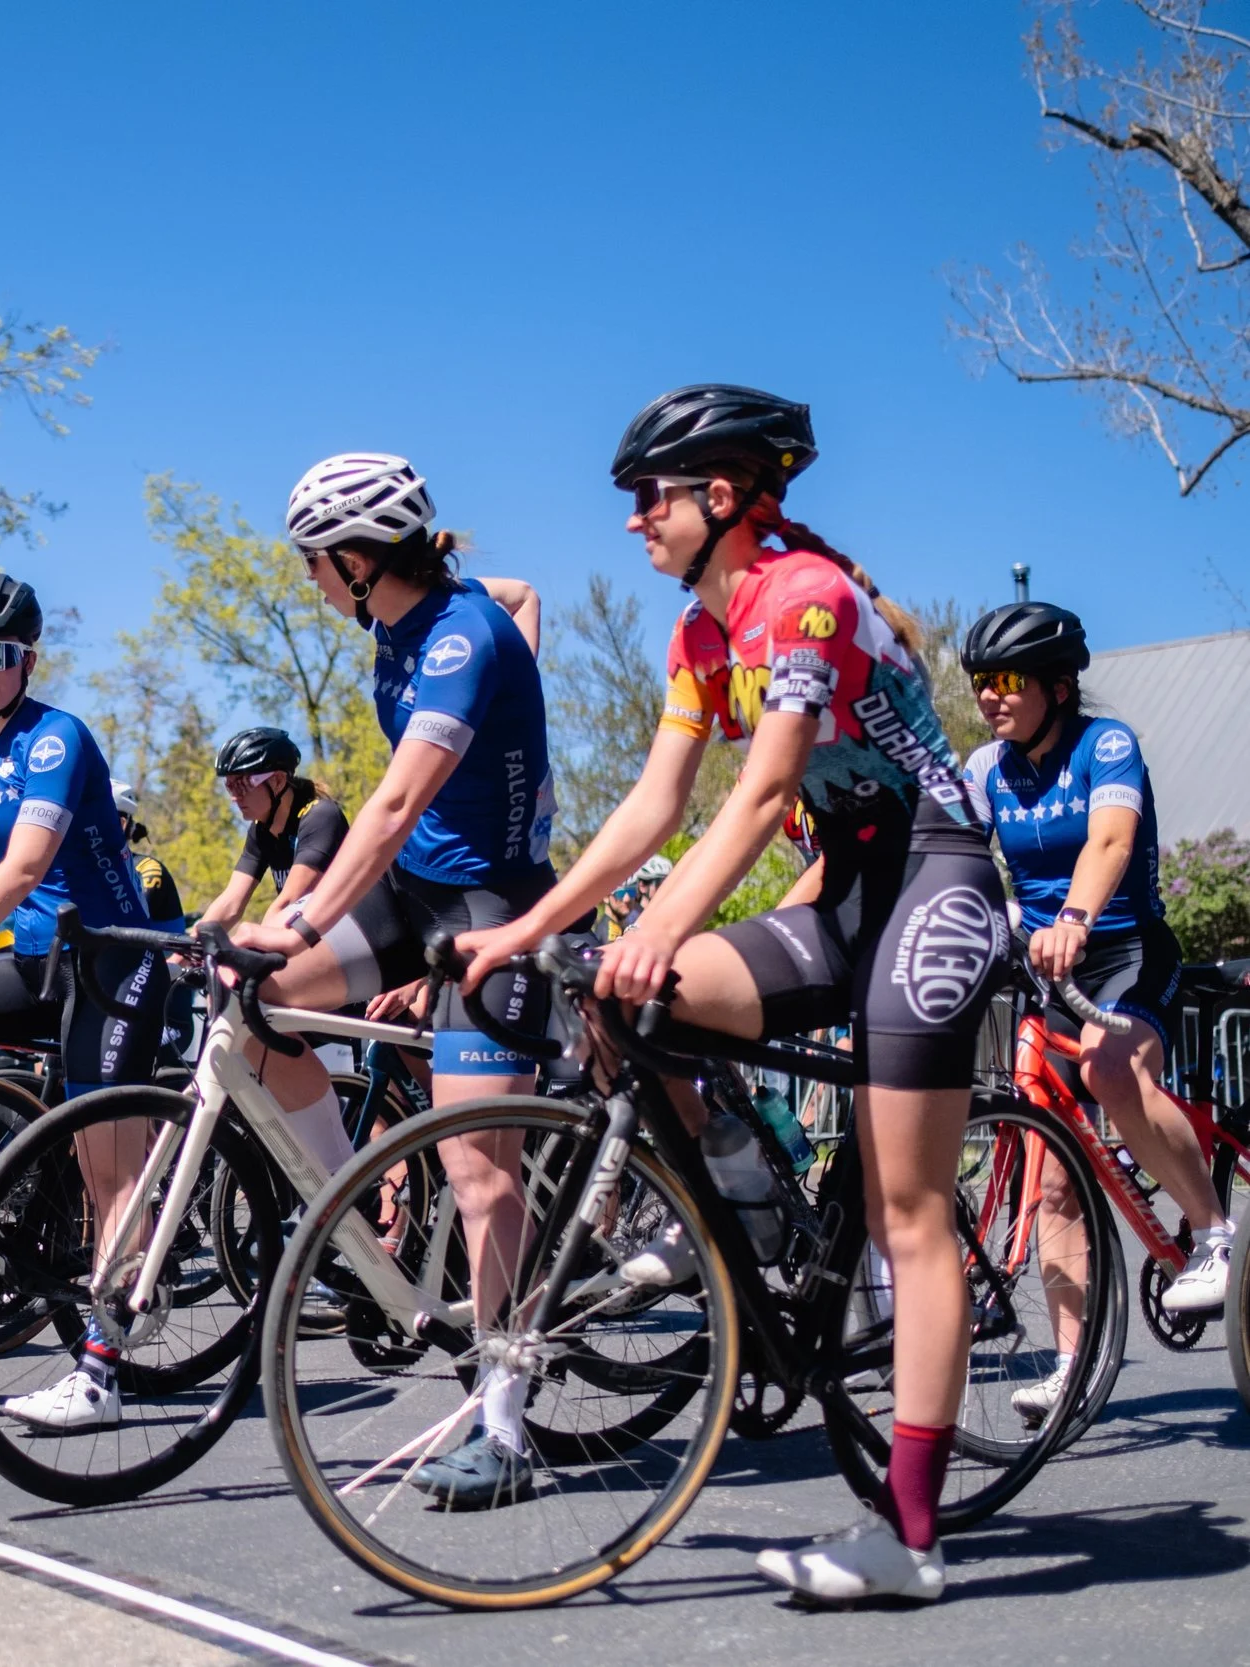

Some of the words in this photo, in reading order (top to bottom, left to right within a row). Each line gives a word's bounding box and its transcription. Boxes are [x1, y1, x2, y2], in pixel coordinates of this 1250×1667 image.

[417, 719, 459, 741] FORCE
[853, 691, 963, 805] DURANGO
[31, 806, 64, 824] FORCE
[505, 749, 527, 860] FALCONS
[84, 825, 133, 914] FALCONS
[890, 904, 929, 985] Durango
[912, 897, 991, 1011] DEVO
[101, 1050, 118, 1073] US
[130, 950, 156, 993] FORCE
[506, 997, 524, 1021] US
